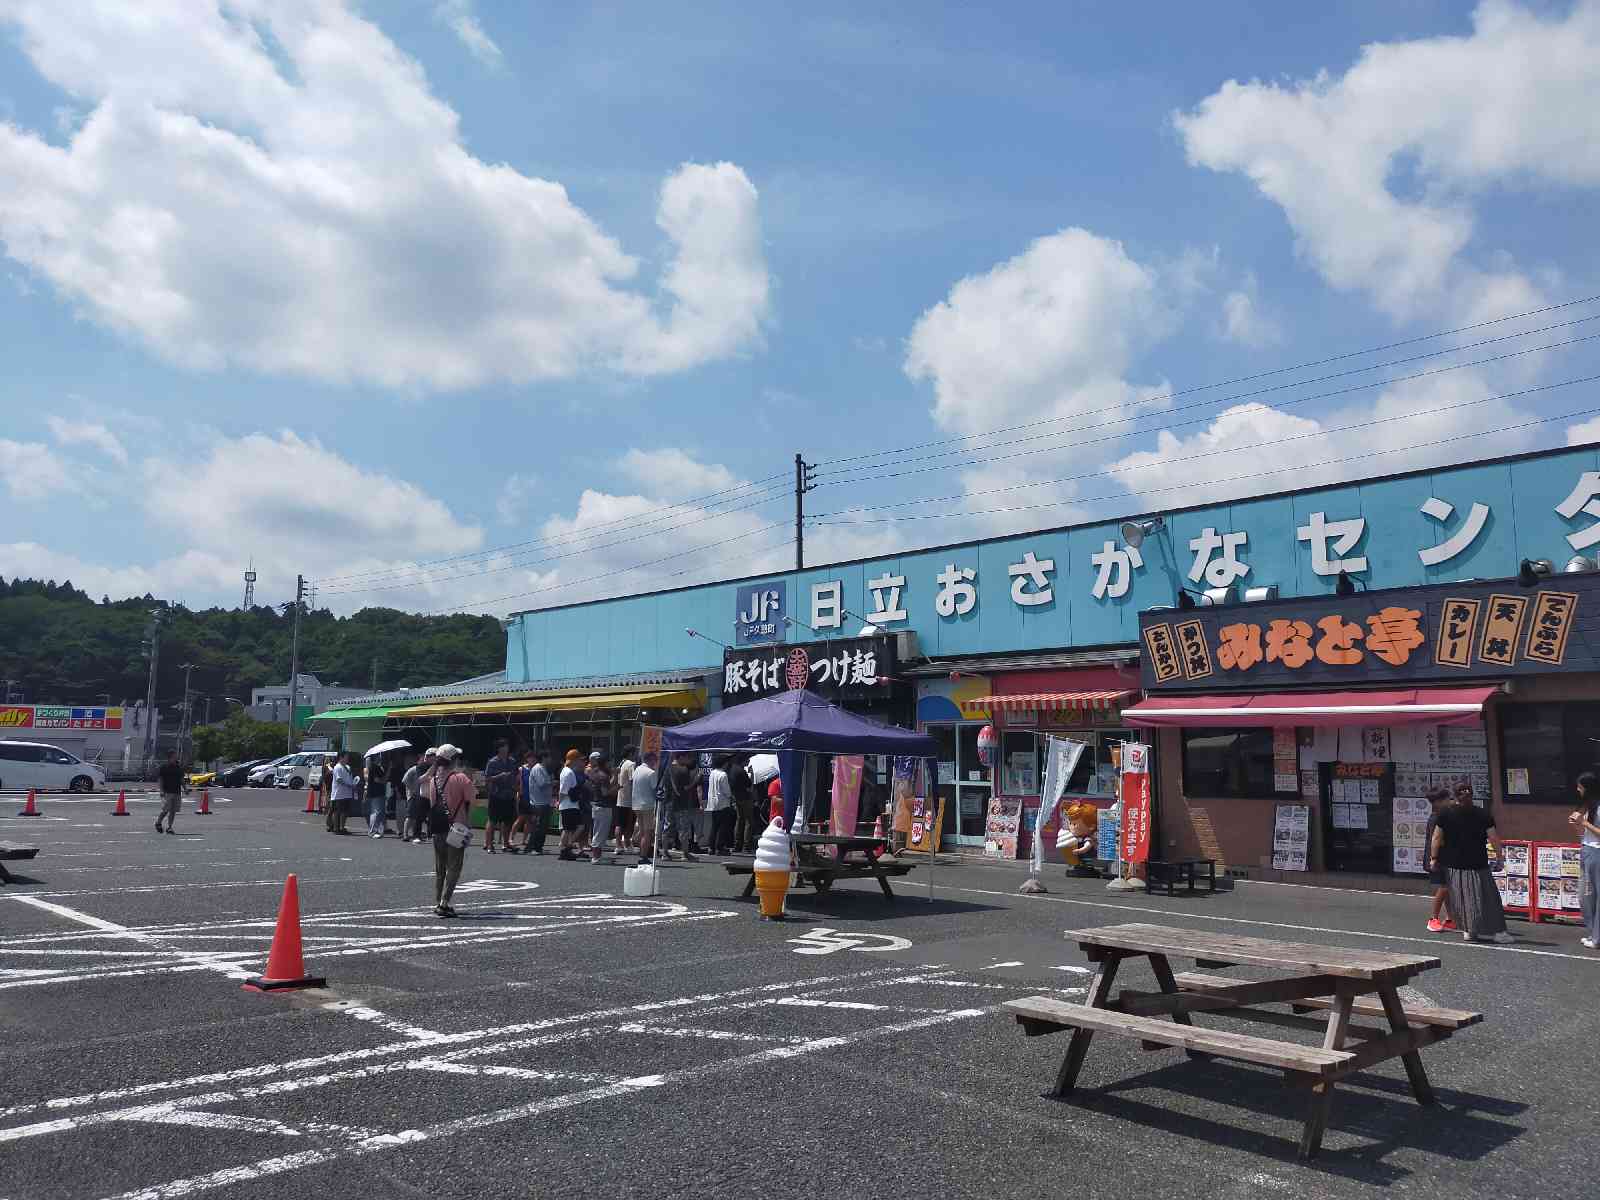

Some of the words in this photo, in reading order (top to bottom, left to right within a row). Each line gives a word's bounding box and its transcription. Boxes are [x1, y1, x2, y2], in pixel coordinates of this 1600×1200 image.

[1184, 626, 1207, 673] かつ丼
[1217, 607, 1424, 669] みなと亭
[1447, 604, 1470, 658] カレー
[1534, 597, 1567, 656] てんぷら
[724, 656, 784, 693] 豚そば
[810, 649, 878, 687] つけ麺
